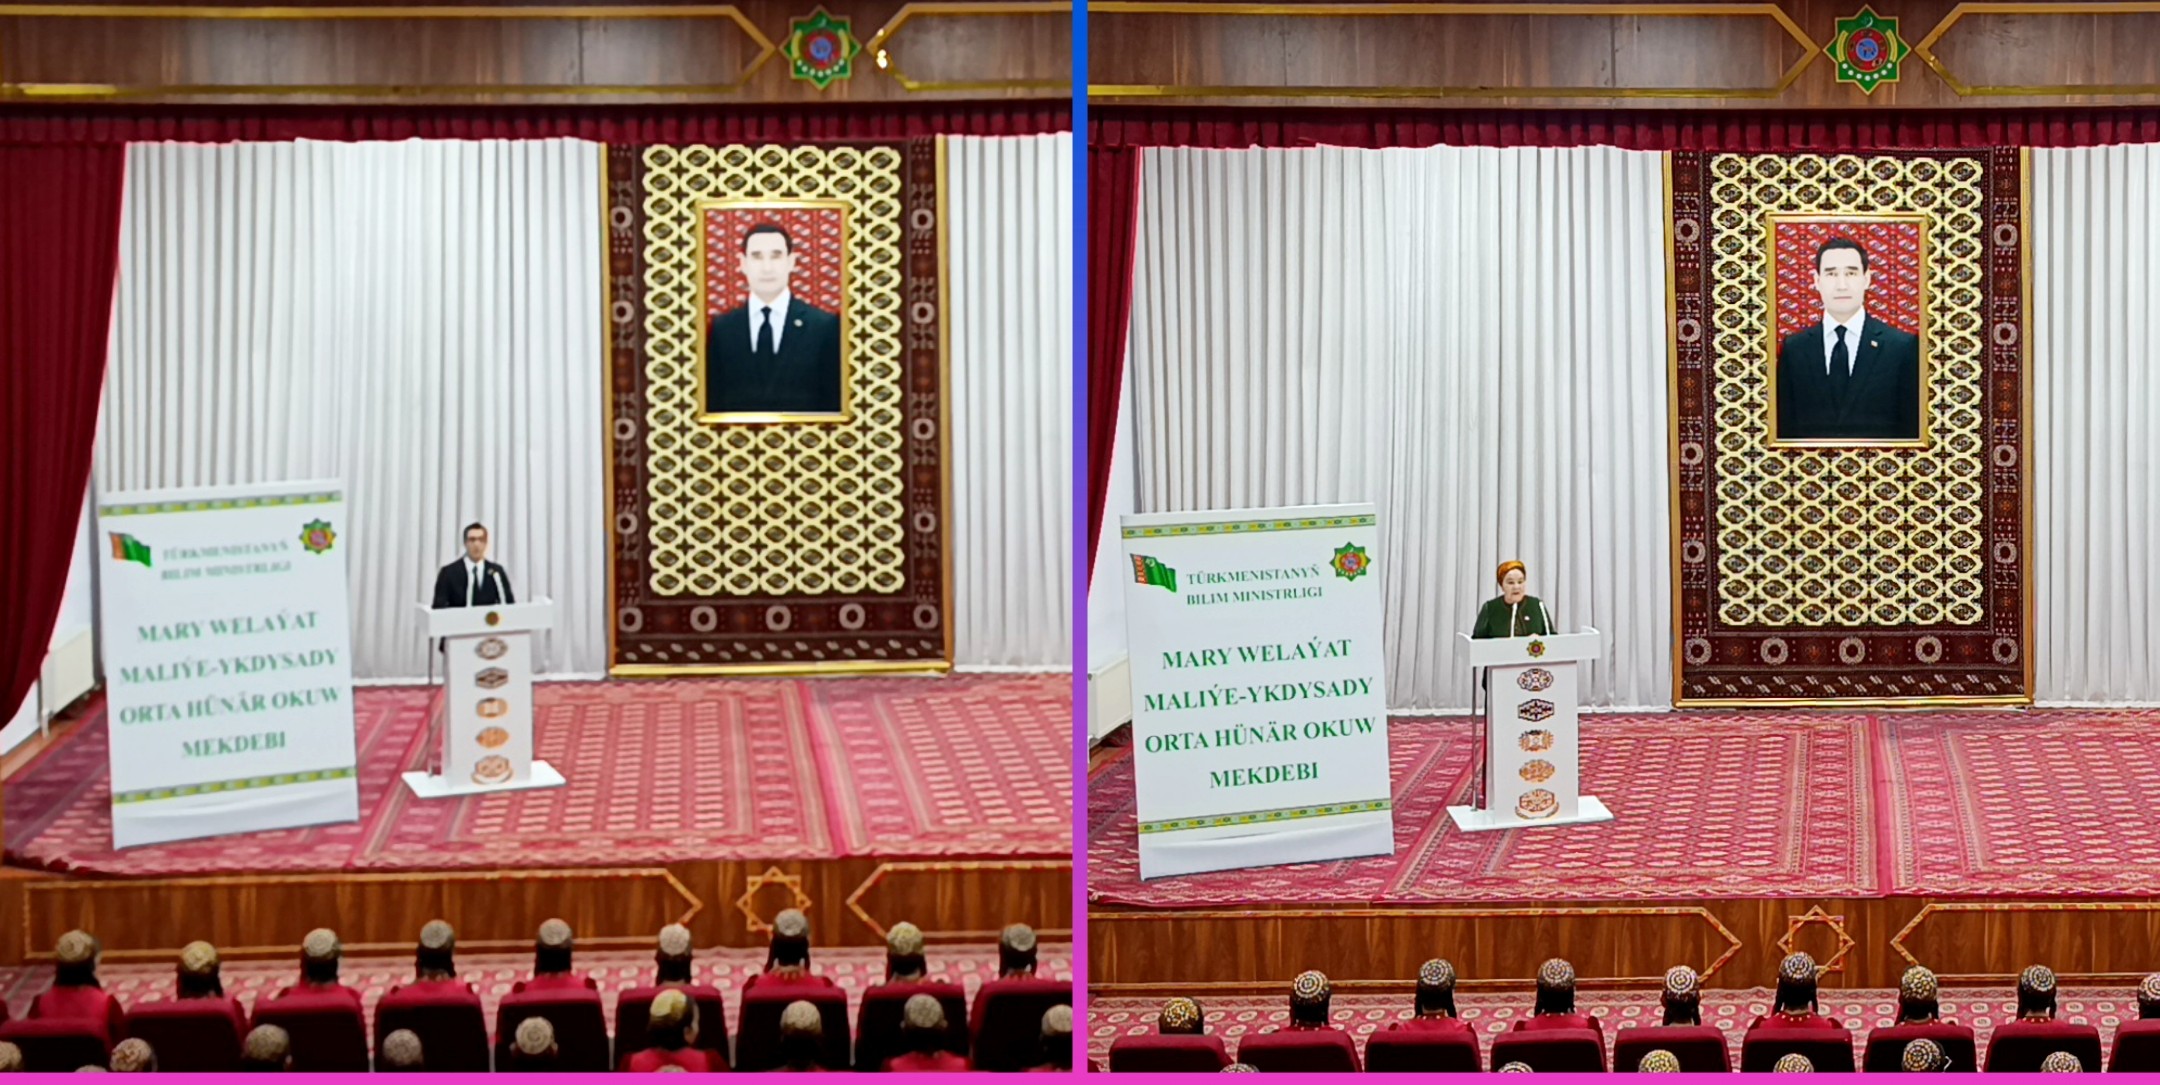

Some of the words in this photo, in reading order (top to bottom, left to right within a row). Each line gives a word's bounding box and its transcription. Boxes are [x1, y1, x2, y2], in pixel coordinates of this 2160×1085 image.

[1186, 564, 1320, 585] TÜRKMENISTANYŇ
[1187, 592, 1228, 605] BILIM
[1233, 587, 1322, 602] MINISTRLIGI
[138, 621, 202, 642] MARY
[209, 609, 318, 636] WELAÝAT
[119, 648, 338, 684] MALIÝE-YKDYSADY
[1163, 648, 1231, 669] MARY
[1237, 636, 1351, 662] WELAÝAT
[119, 704, 182, 725] ORTA
[187, 692, 267, 718] HÜNÄR
[271, 687, 341, 709] OKUW
[1145, 677, 1372, 711] MALIÝE-YKDYSADY
[182, 731, 286, 758] MEKDEBI
[1145, 732, 1209, 753] ORTA
[1215, 721, 1297, 747] HÜNÄR
[1304, 718, 1375, 739] OKUW
[1210, 762, 1318, 788] MEKDEBI
